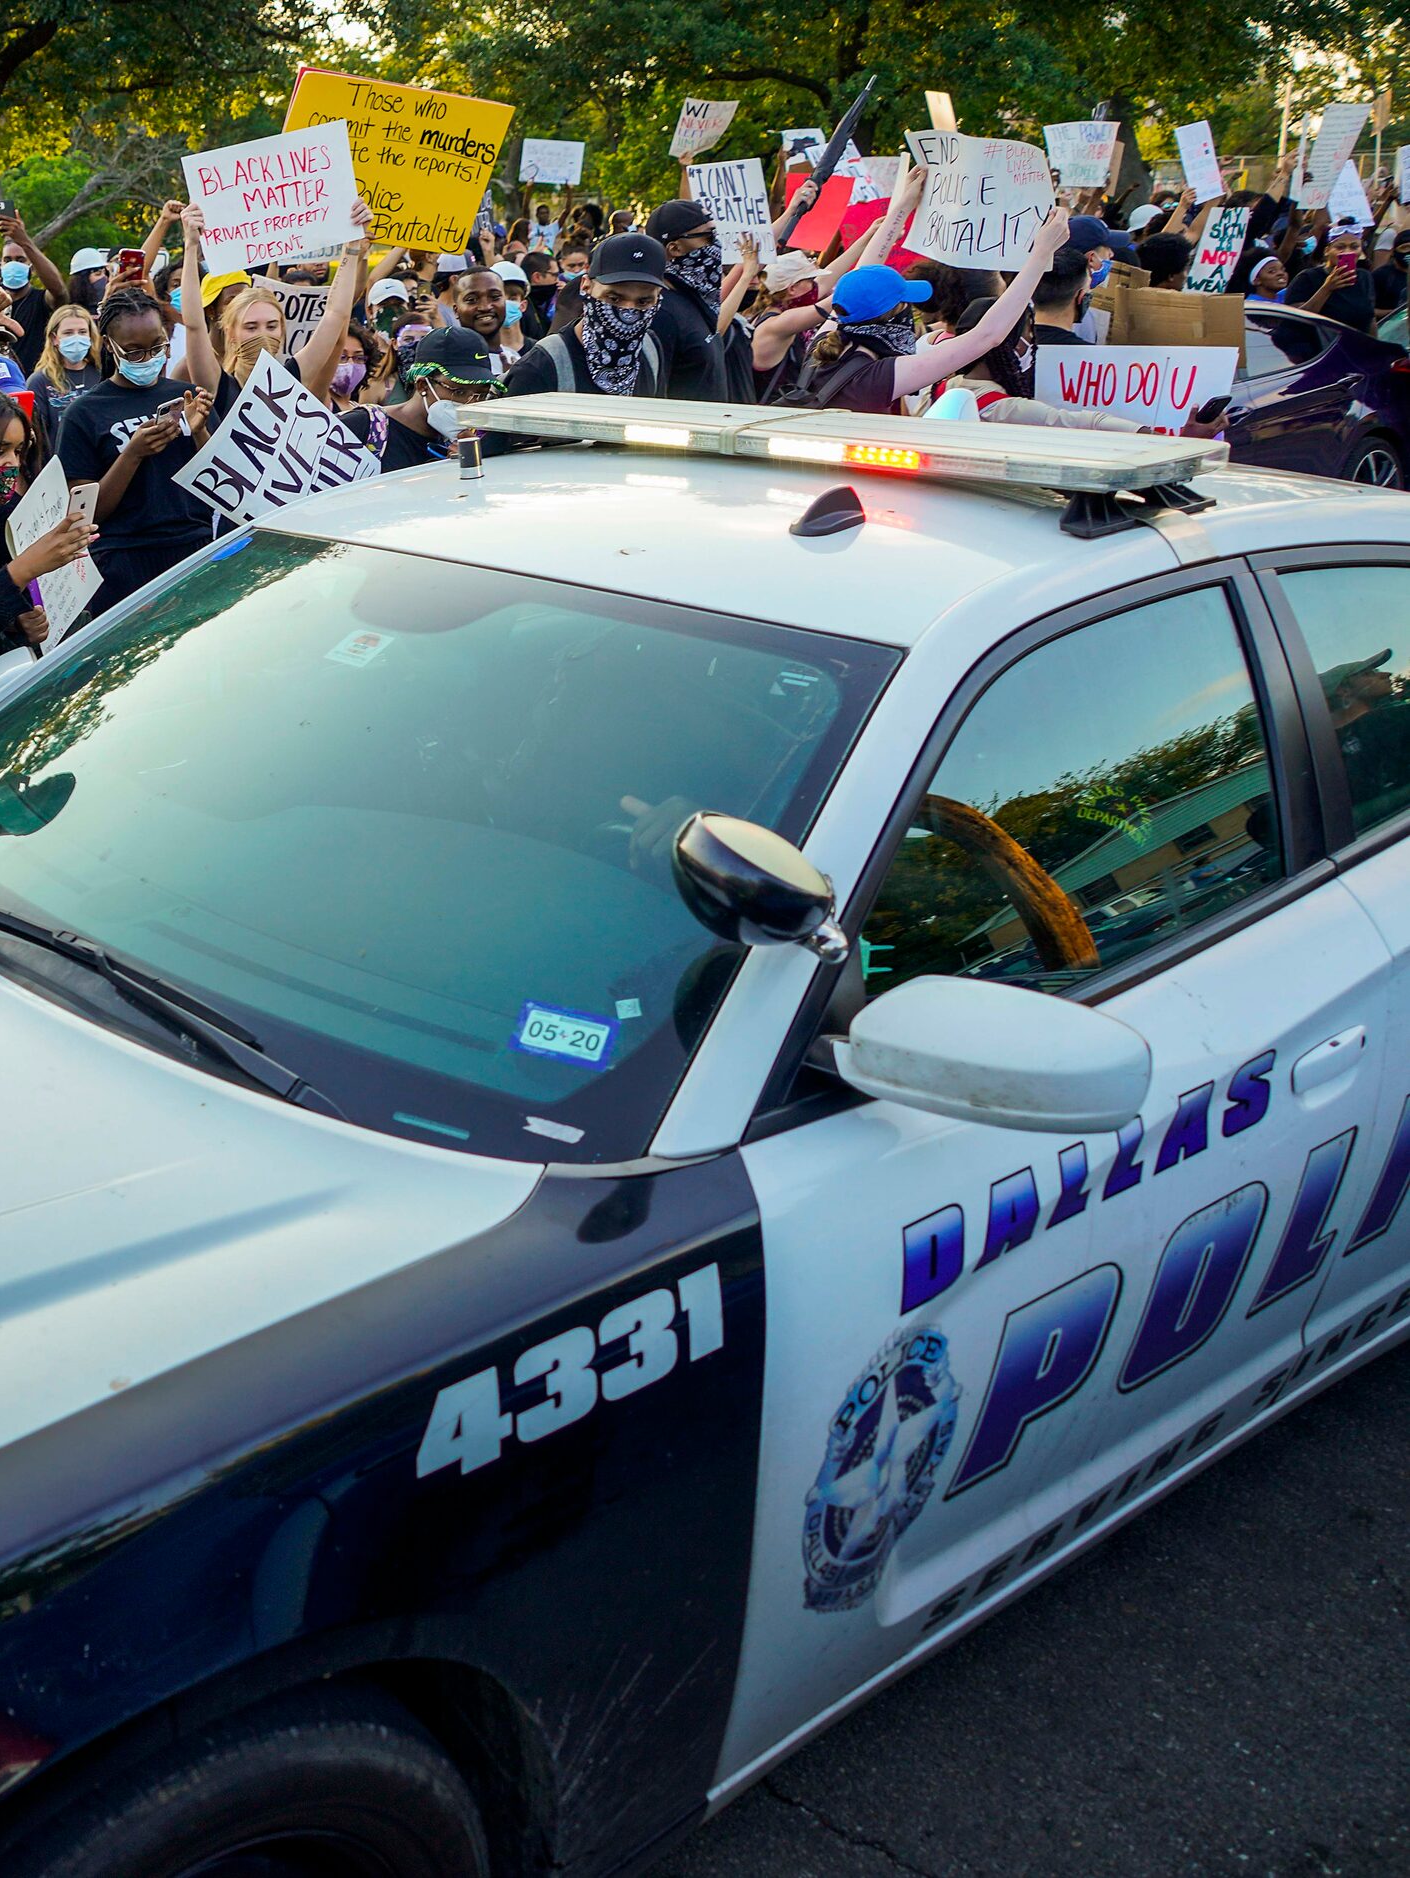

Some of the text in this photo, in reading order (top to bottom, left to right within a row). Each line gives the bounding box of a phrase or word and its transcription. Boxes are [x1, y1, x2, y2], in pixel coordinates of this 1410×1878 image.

[348, 82, 448, 120] Those who
[382, 120, 414, 141] the
[419, 128, 496, 165] murders
[918, 137, 960, 165] END
[198, 155, 275, 197] BLACK
[276, 145, 331, 179] LIVES
[377, 147, 406, 167] the
[413, 155, 483, 185] reports!
[1006, 158, 1033, 173] LIVES
[243, 178, 330, 213] MATTER
[929, 173, 997, 207] POLICE
[202, 206, 330, 247] PRIVATE PROPERTY
[371, 213, 467, 253] Brutality
[922, 204, 1053, 258] BRUTALITY
[1210, 222, 1247, 239] SKIN
[1218, 208, 1244, 227] MY
[1200, 249, 1238, 267] NOT
[1209, 264, 1224, 279] A
[1059, 360, 1198, 410] WHO DO U
[191, 366, 296, 513] BLACK
[243, 392, 331, 522] IVES
[528, 1020, 600, 1051] 05 20
[900, 1049, 1278, 1316] DALLAS
[416, 1262, 725, 1479] 4331
[834, 1333, 945, 1436] POLICE
[921, 1412, 1226, 1632] SERVING
